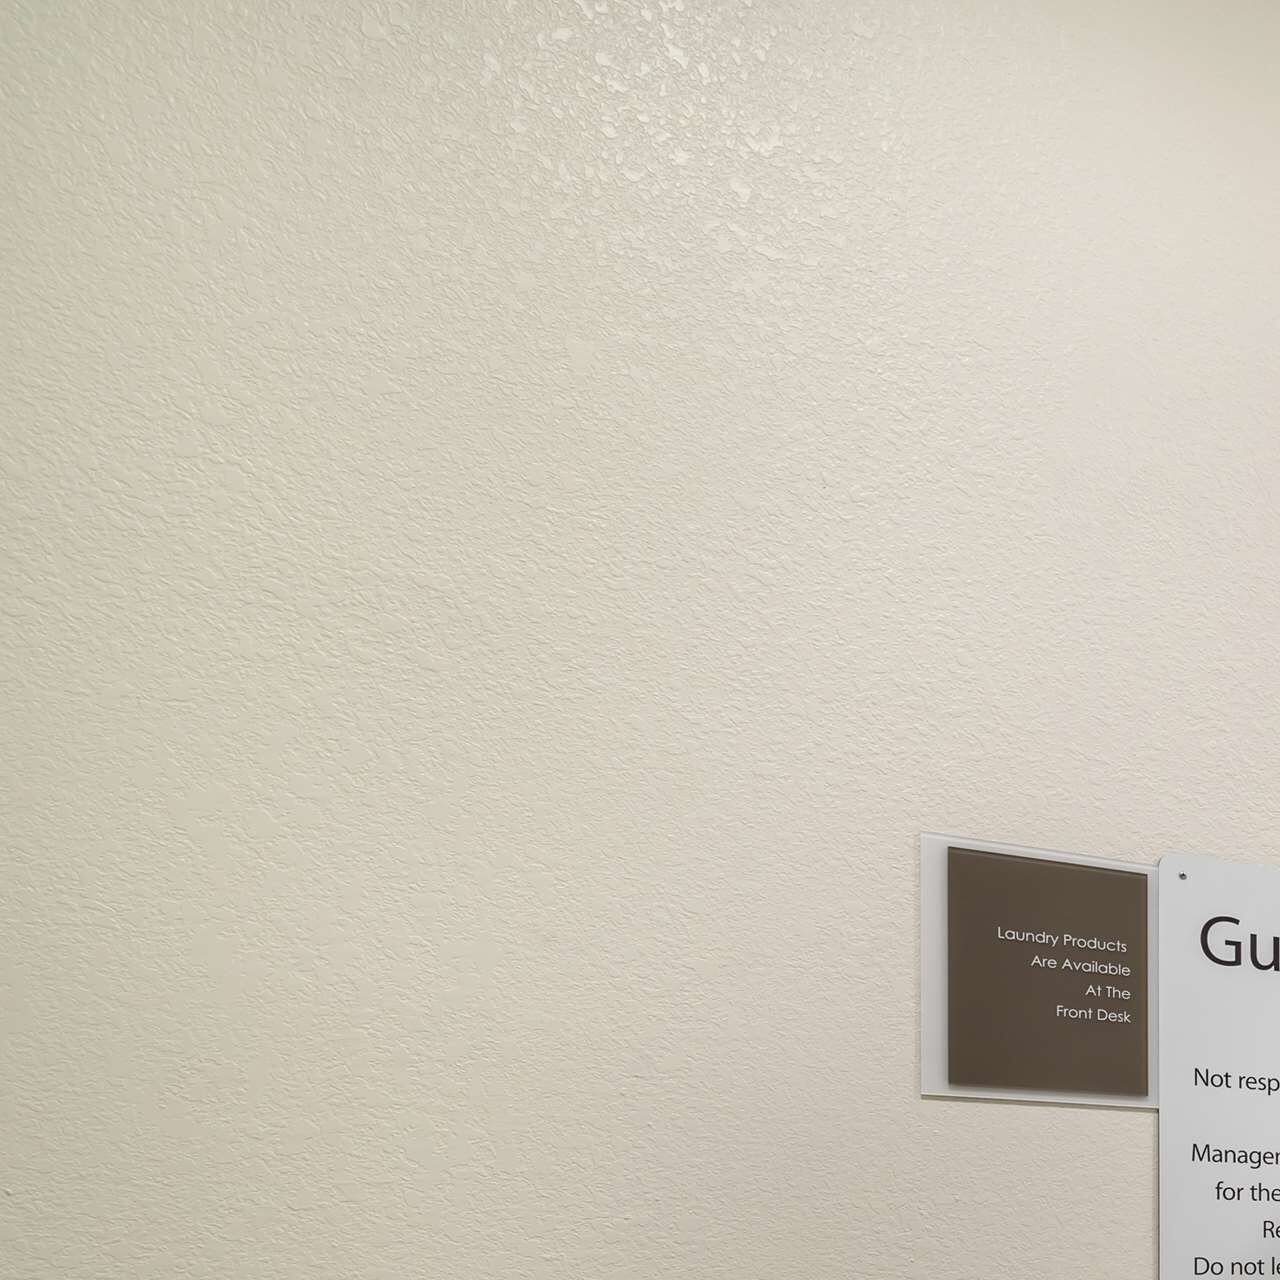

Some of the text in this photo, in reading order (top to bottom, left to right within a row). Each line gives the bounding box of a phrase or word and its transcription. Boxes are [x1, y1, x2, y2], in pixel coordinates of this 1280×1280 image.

[997, 925, 1128, 953] Laundry Products
[1030, 954, 1132, 977] Are Available
[1084, 984, 1132, 1000] At The
[1056, 1004, 1132, 1024] Front Desk
[1194, 1067, 1233, 1089] Not
[1214, 1180, 1245, 1201] for
[1193, 1256, 1224, 1276] Do
[1230, 1259, 1265, 1276] not
